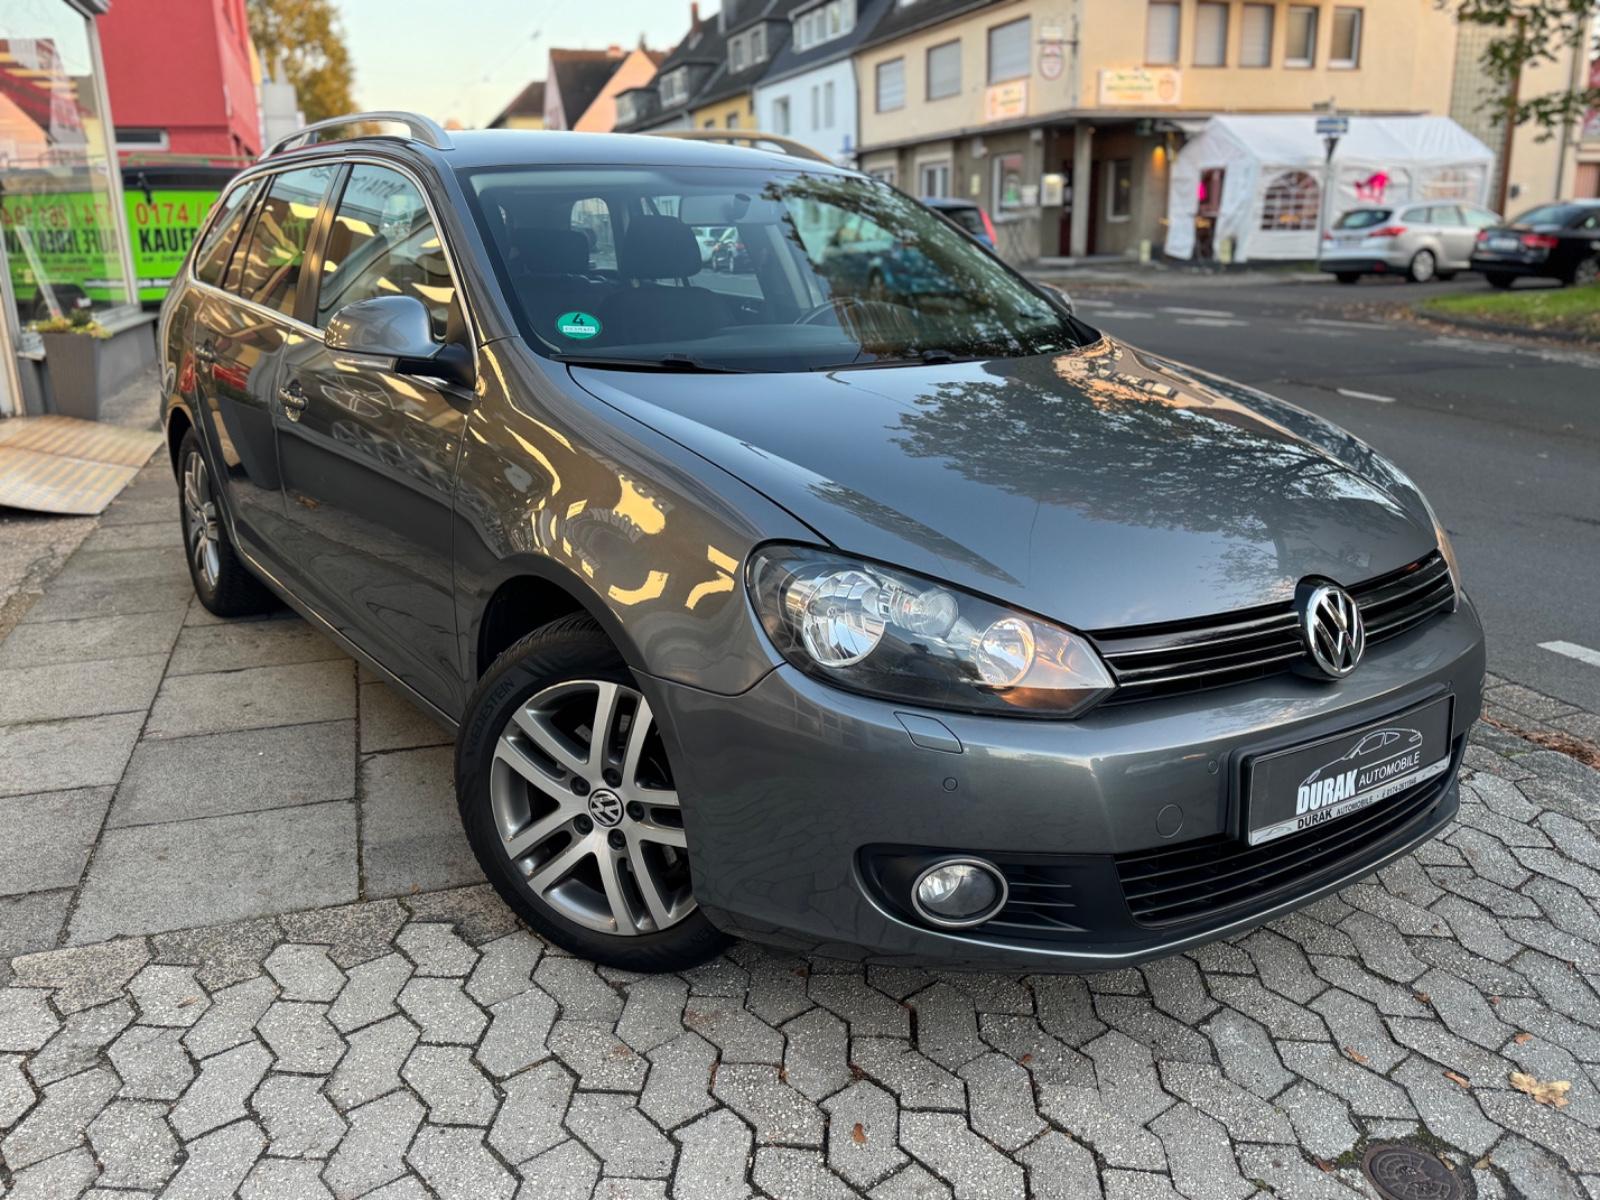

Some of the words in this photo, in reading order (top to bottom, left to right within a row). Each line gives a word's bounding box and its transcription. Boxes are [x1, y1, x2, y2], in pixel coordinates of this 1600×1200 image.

[136, 202, 188, 225] 0174
[1296, 768, 1358, 815] DURAK
[1359, 751, 1420, 787] AUTOMOBILE
[1297, 810, 1332, 829] DURAK
